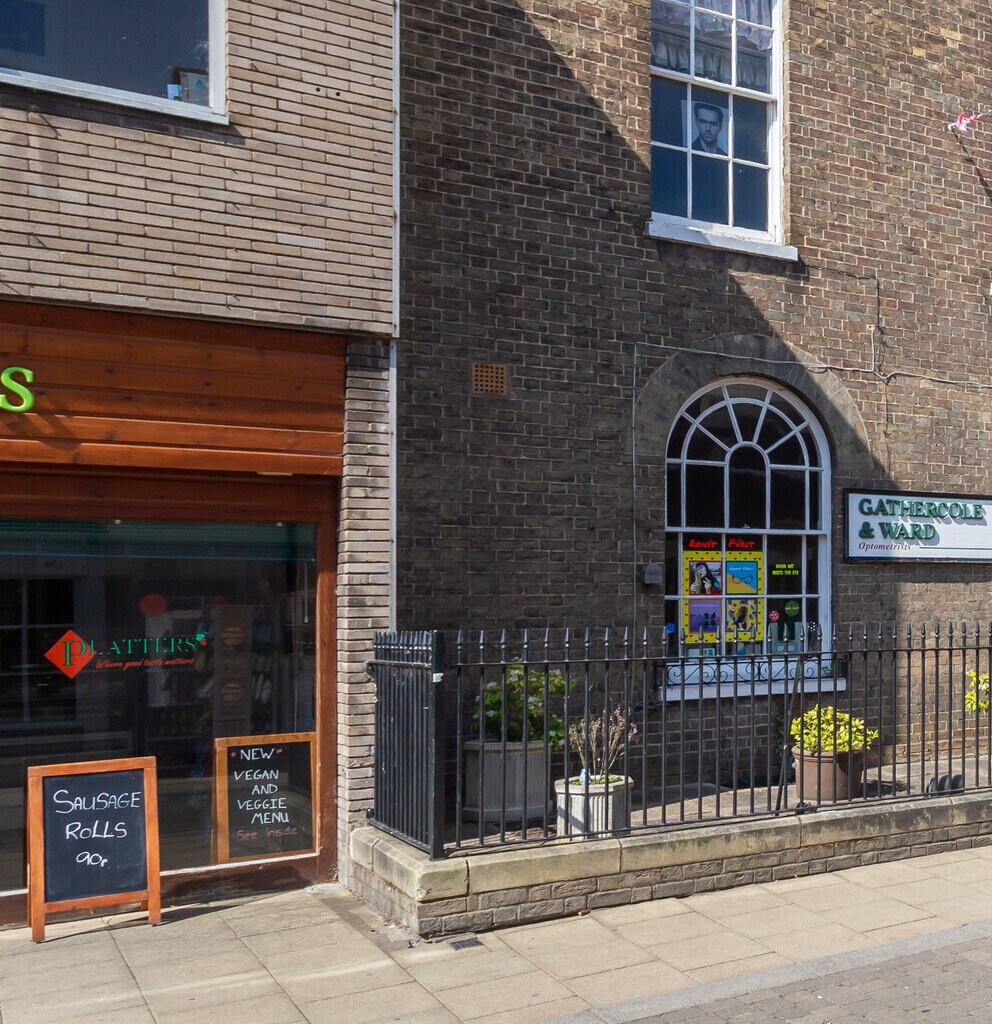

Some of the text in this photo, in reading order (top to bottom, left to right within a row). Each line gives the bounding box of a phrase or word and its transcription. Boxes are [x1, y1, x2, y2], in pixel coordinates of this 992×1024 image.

[0, 366, 34, 412] S
[858, 498, 984, 520] GATHERCOLE
[858, 521, 936, 540] & WARD
[858, 542, 912, 552] Optometrists
[63, 636, 197, 666] PLATTERS
[96, 658, 123, 669] Where
[240, 748, 274, 760] NEW
[234, 769, 279, 781] VEGAN
[251, 784, 278, 795] AND
[53, 789, 142, 814] SAUSAGE
[237, 798, 287, 810] VEGGIE
[251, 812, 289, 824] MENU
[236, 829, 258, 840] See
